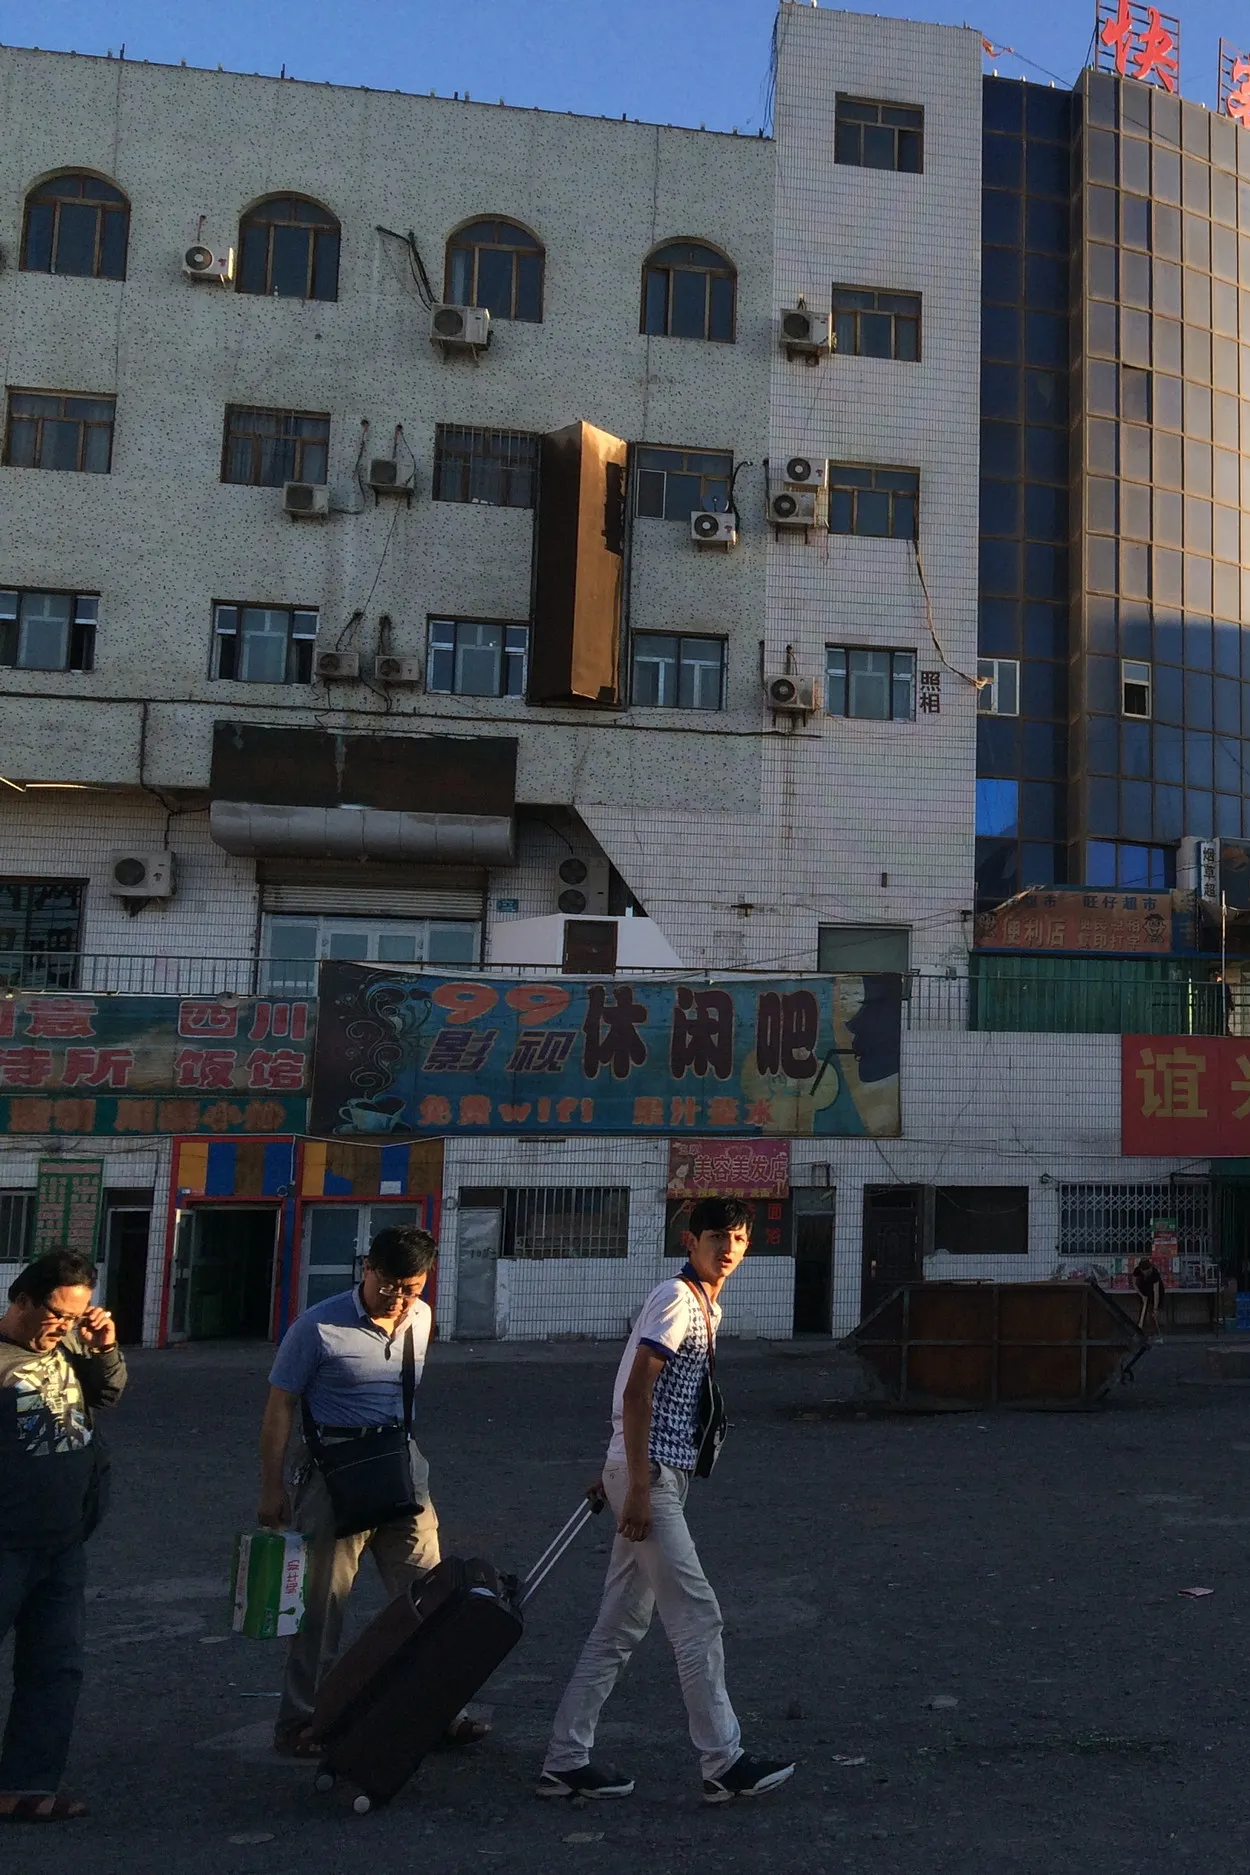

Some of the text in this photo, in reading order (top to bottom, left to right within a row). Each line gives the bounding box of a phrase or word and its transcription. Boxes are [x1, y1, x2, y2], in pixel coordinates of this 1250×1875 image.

[920, 671, 941, 713] 照相
[1083, 895, 1158, 911] 旺仔超市
[1002, 916, 1068, 947] 便利店
[0, 997, 308, 1041] 意 四川
[432, 983, 570, 1024] 99
[421, 1029, 577, 1072] 影视
[581, 984, 820, 1080] 休闲吧
[174, 1048, 306, 1090] 饭馆
[693, 1154, 788, 1182] 美容美发店
